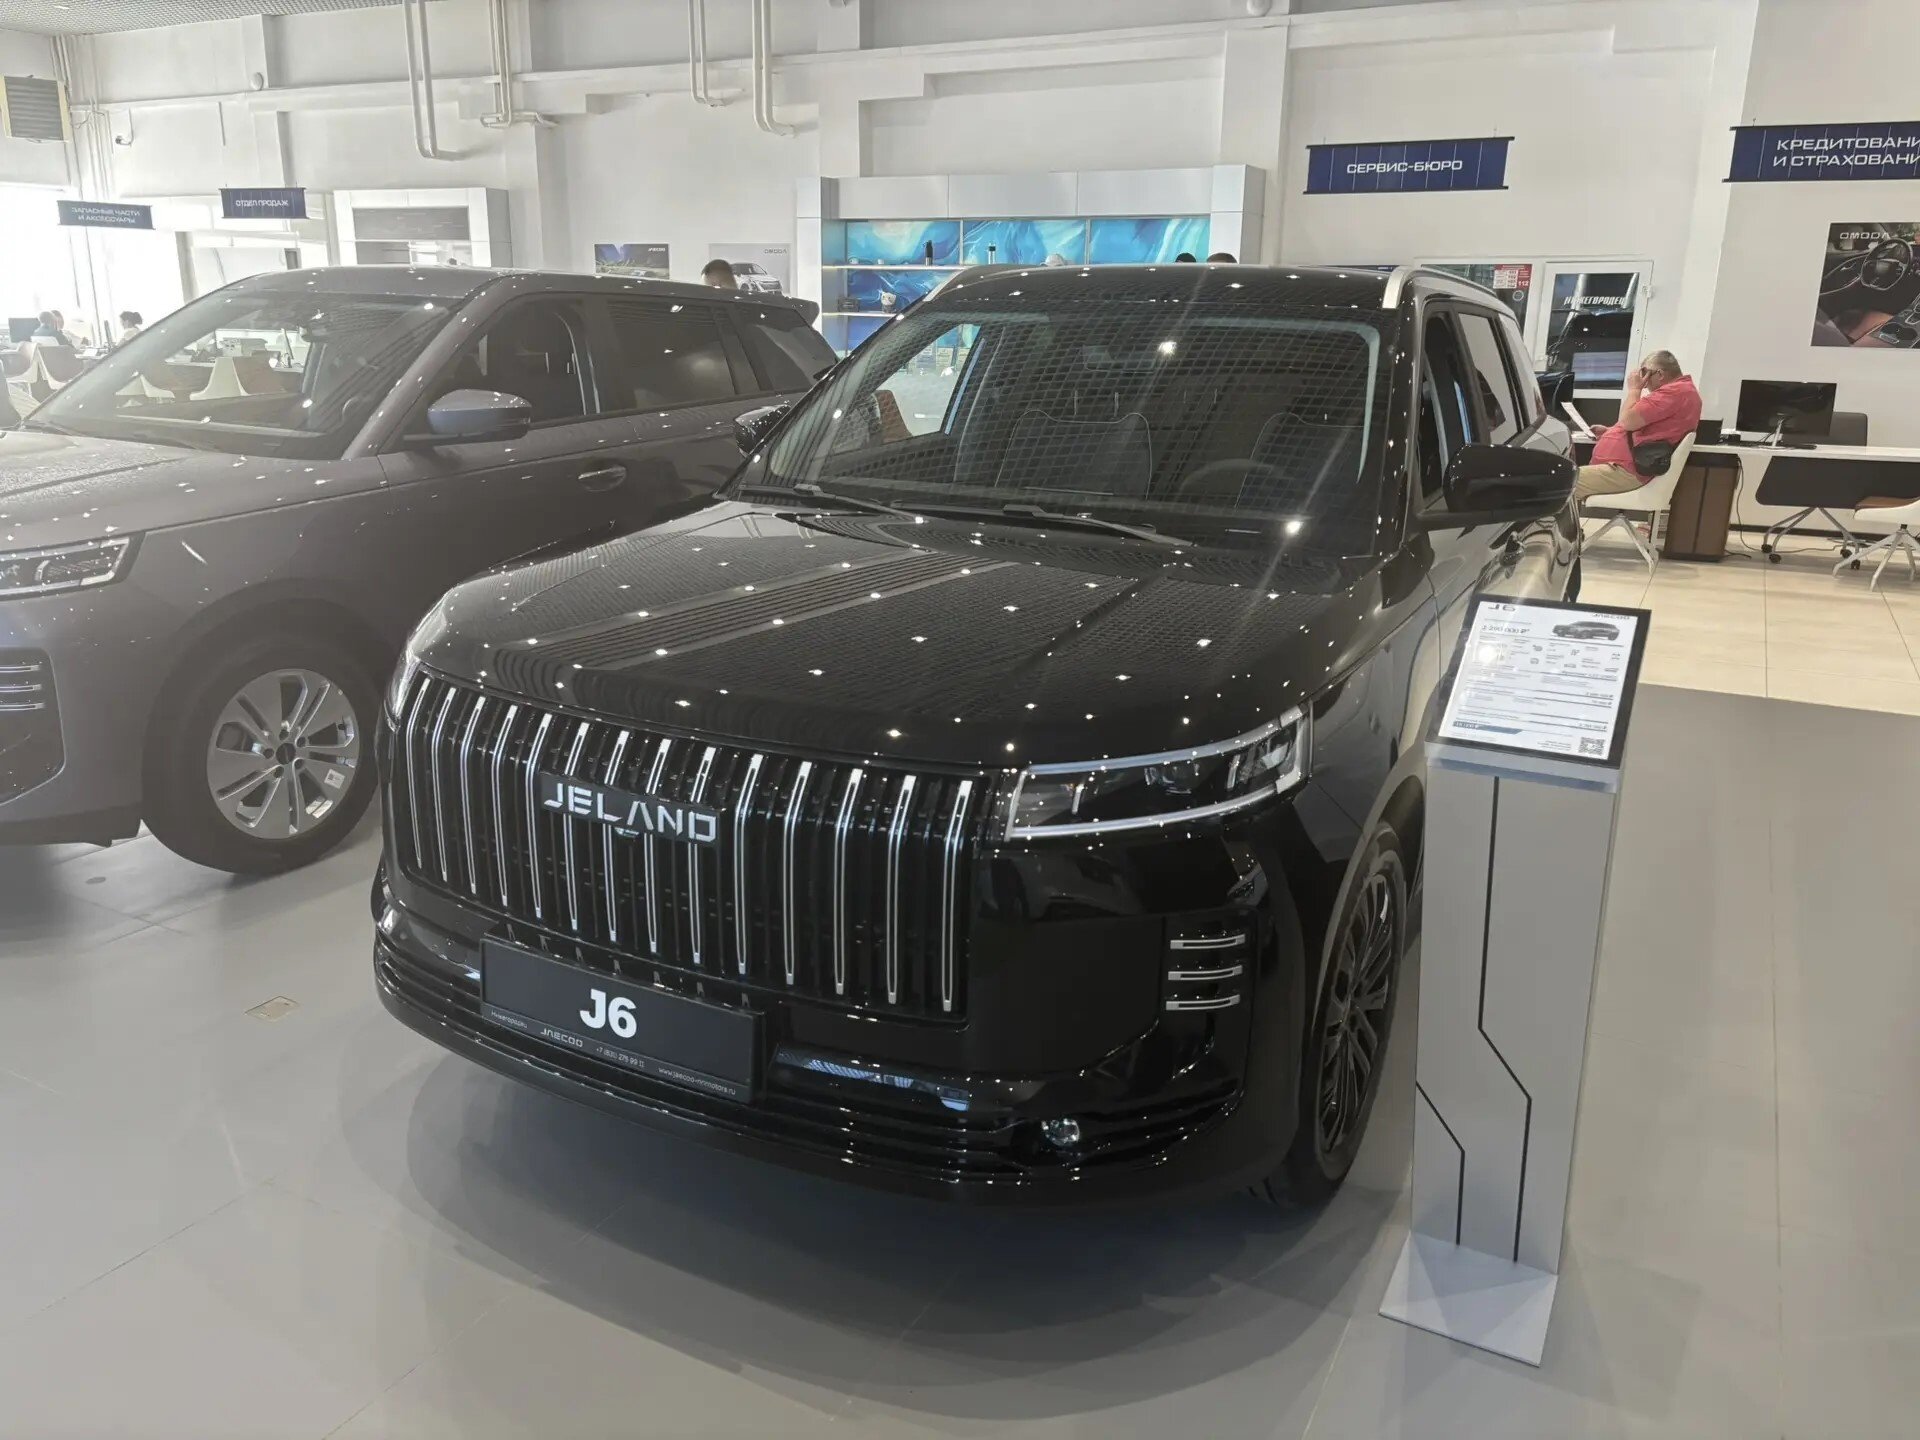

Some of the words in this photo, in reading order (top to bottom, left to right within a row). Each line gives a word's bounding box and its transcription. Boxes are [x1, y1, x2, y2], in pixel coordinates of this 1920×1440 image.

[1346, 160, 1463, 174] СЕРВИС-БЮРО
[1773, 156, 1787, 167] И
[235, 199, 257, 207] ОТДЕЛ
[258, 199, 289, 207] ПРОДАЖ
[1839, 232, 1891, 240] OMODA
[543, 782, 717, 843] JELAND
[579, 988, 637, 1038] J6
[540, 1028, 584, 1048] JAECOO
